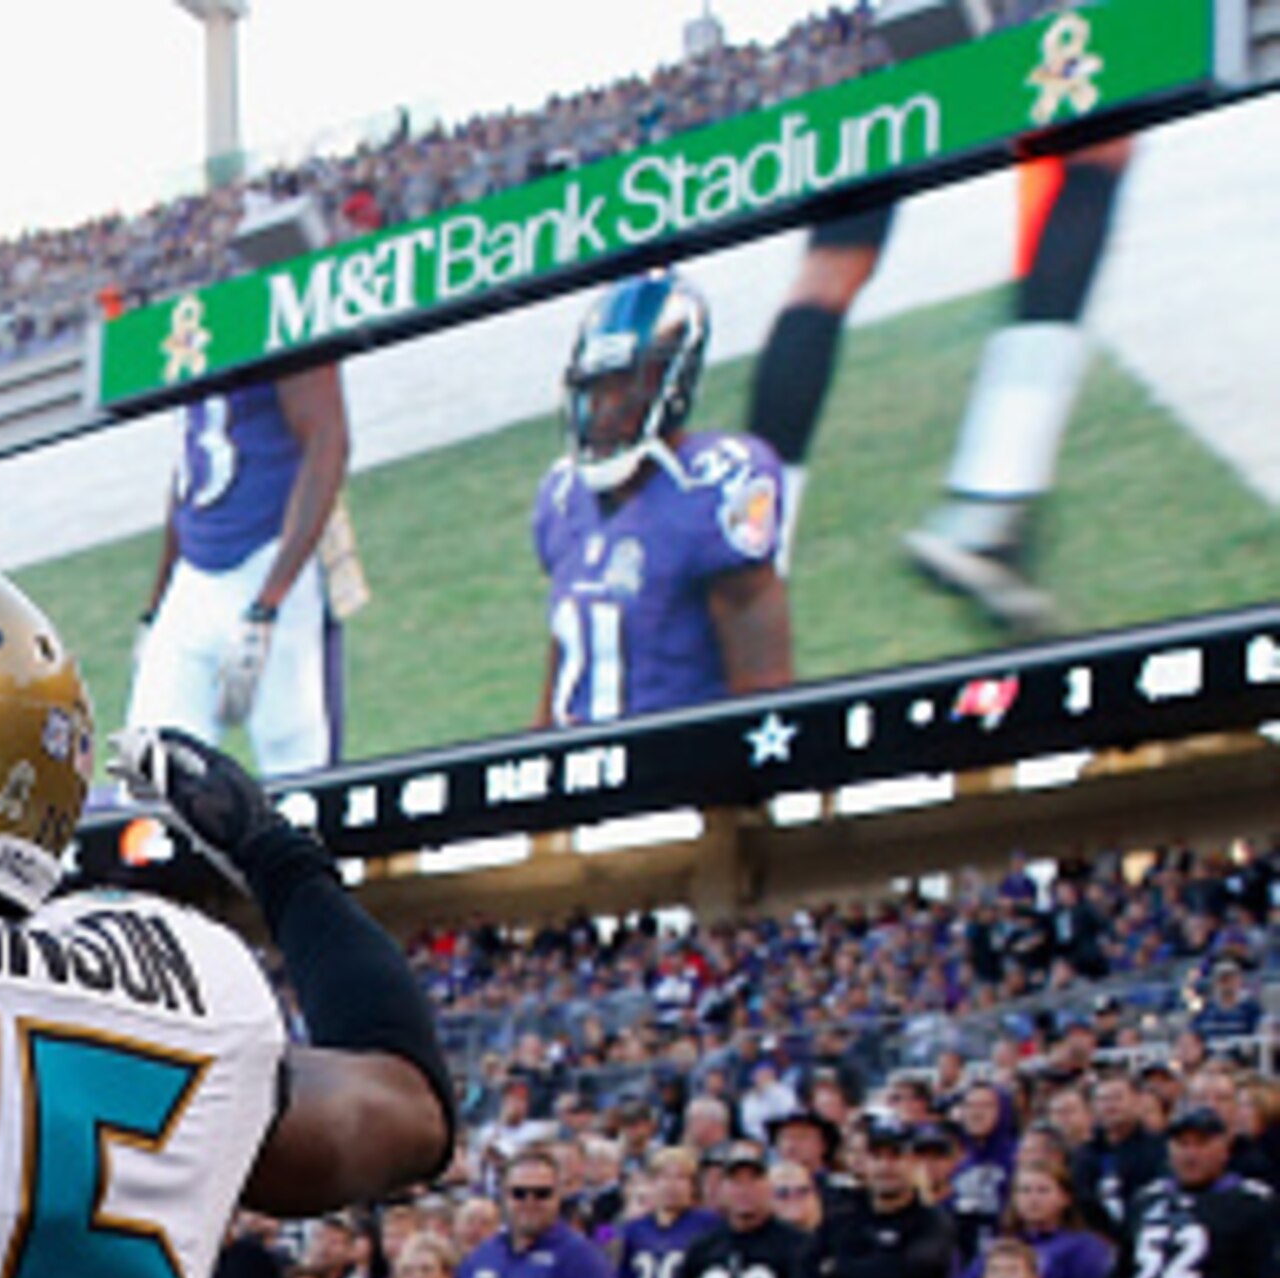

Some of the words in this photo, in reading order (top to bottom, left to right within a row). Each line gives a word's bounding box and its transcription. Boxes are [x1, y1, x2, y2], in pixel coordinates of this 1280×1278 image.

[262, 228, 434, 352] M&T
[438, 182, 608, 300] Bank
[615, 92, 940, 244] Stadium
